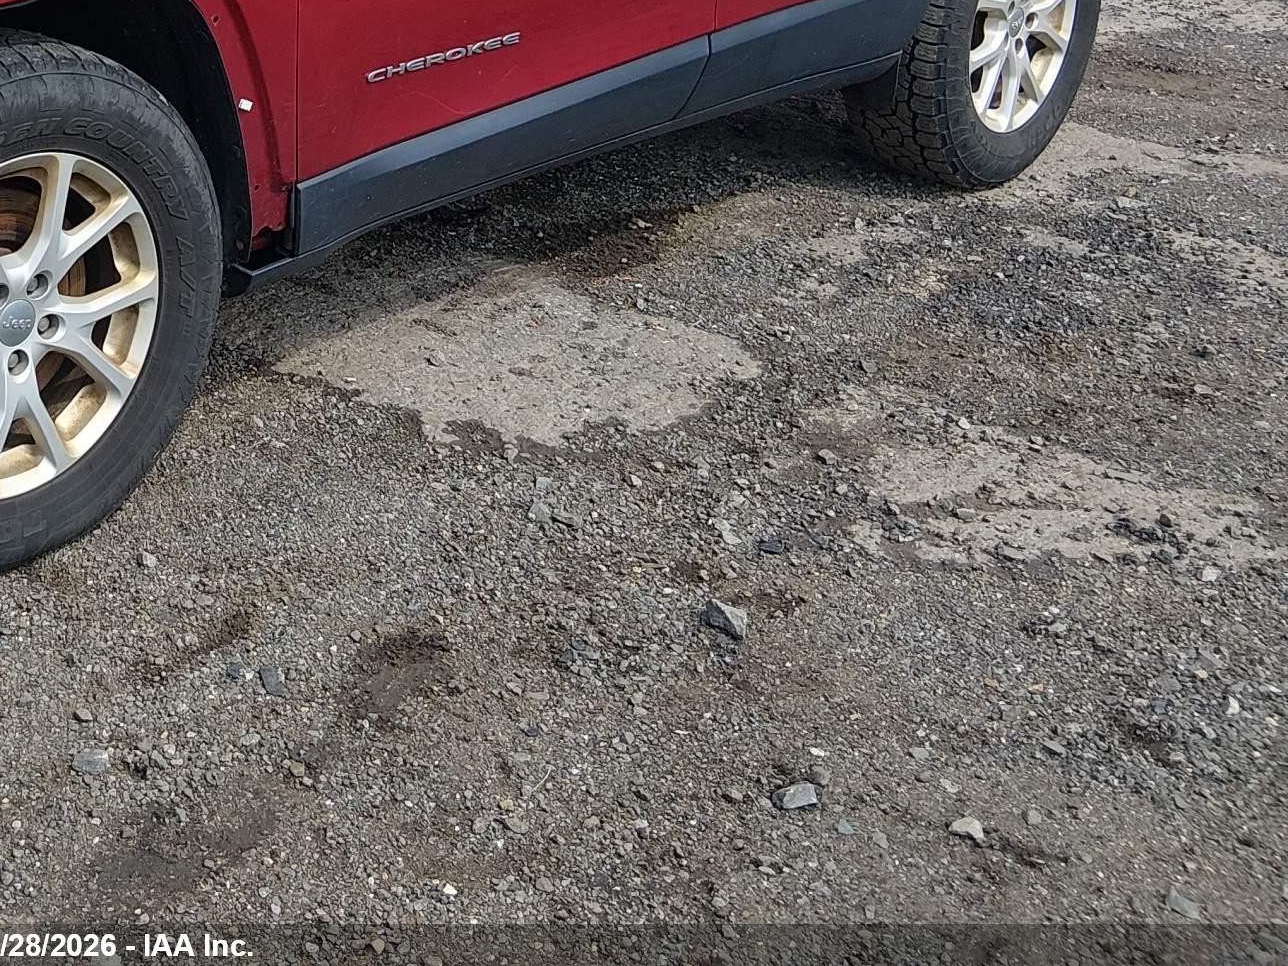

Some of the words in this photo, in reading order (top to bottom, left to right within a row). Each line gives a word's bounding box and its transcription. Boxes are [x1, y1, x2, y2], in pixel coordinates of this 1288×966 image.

[366, 30, 521, 84] CHEROKEE
[65, 117, 192, 221] COUNTRY
[1, 315, 32, 332] Jeep
